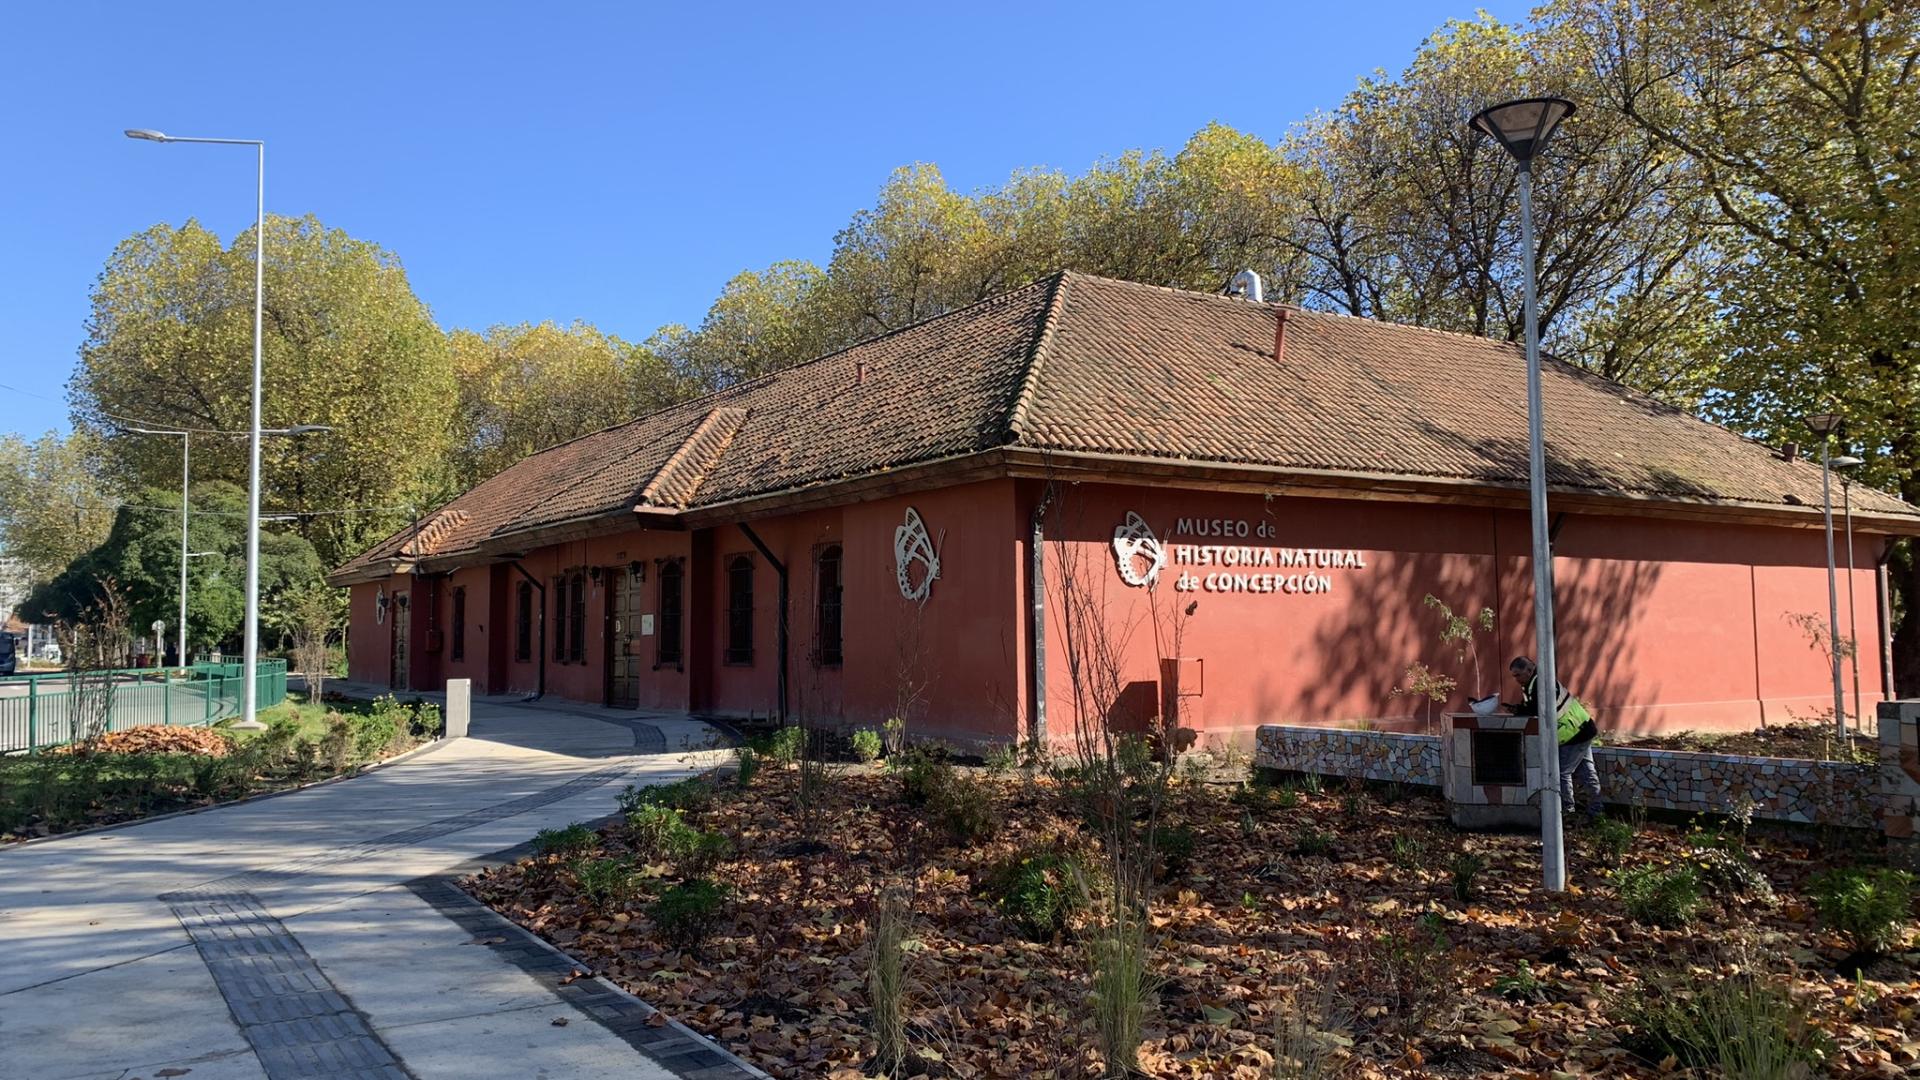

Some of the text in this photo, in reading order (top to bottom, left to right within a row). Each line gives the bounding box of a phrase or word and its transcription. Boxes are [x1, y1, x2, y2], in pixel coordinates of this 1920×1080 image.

[1177, 518, 1276, 538] MUSEO de
[1177, 545, 1366, 567] HISTORIA NATURAL
[1178, 570, 1331, 592] de CONCEPCIÓN
